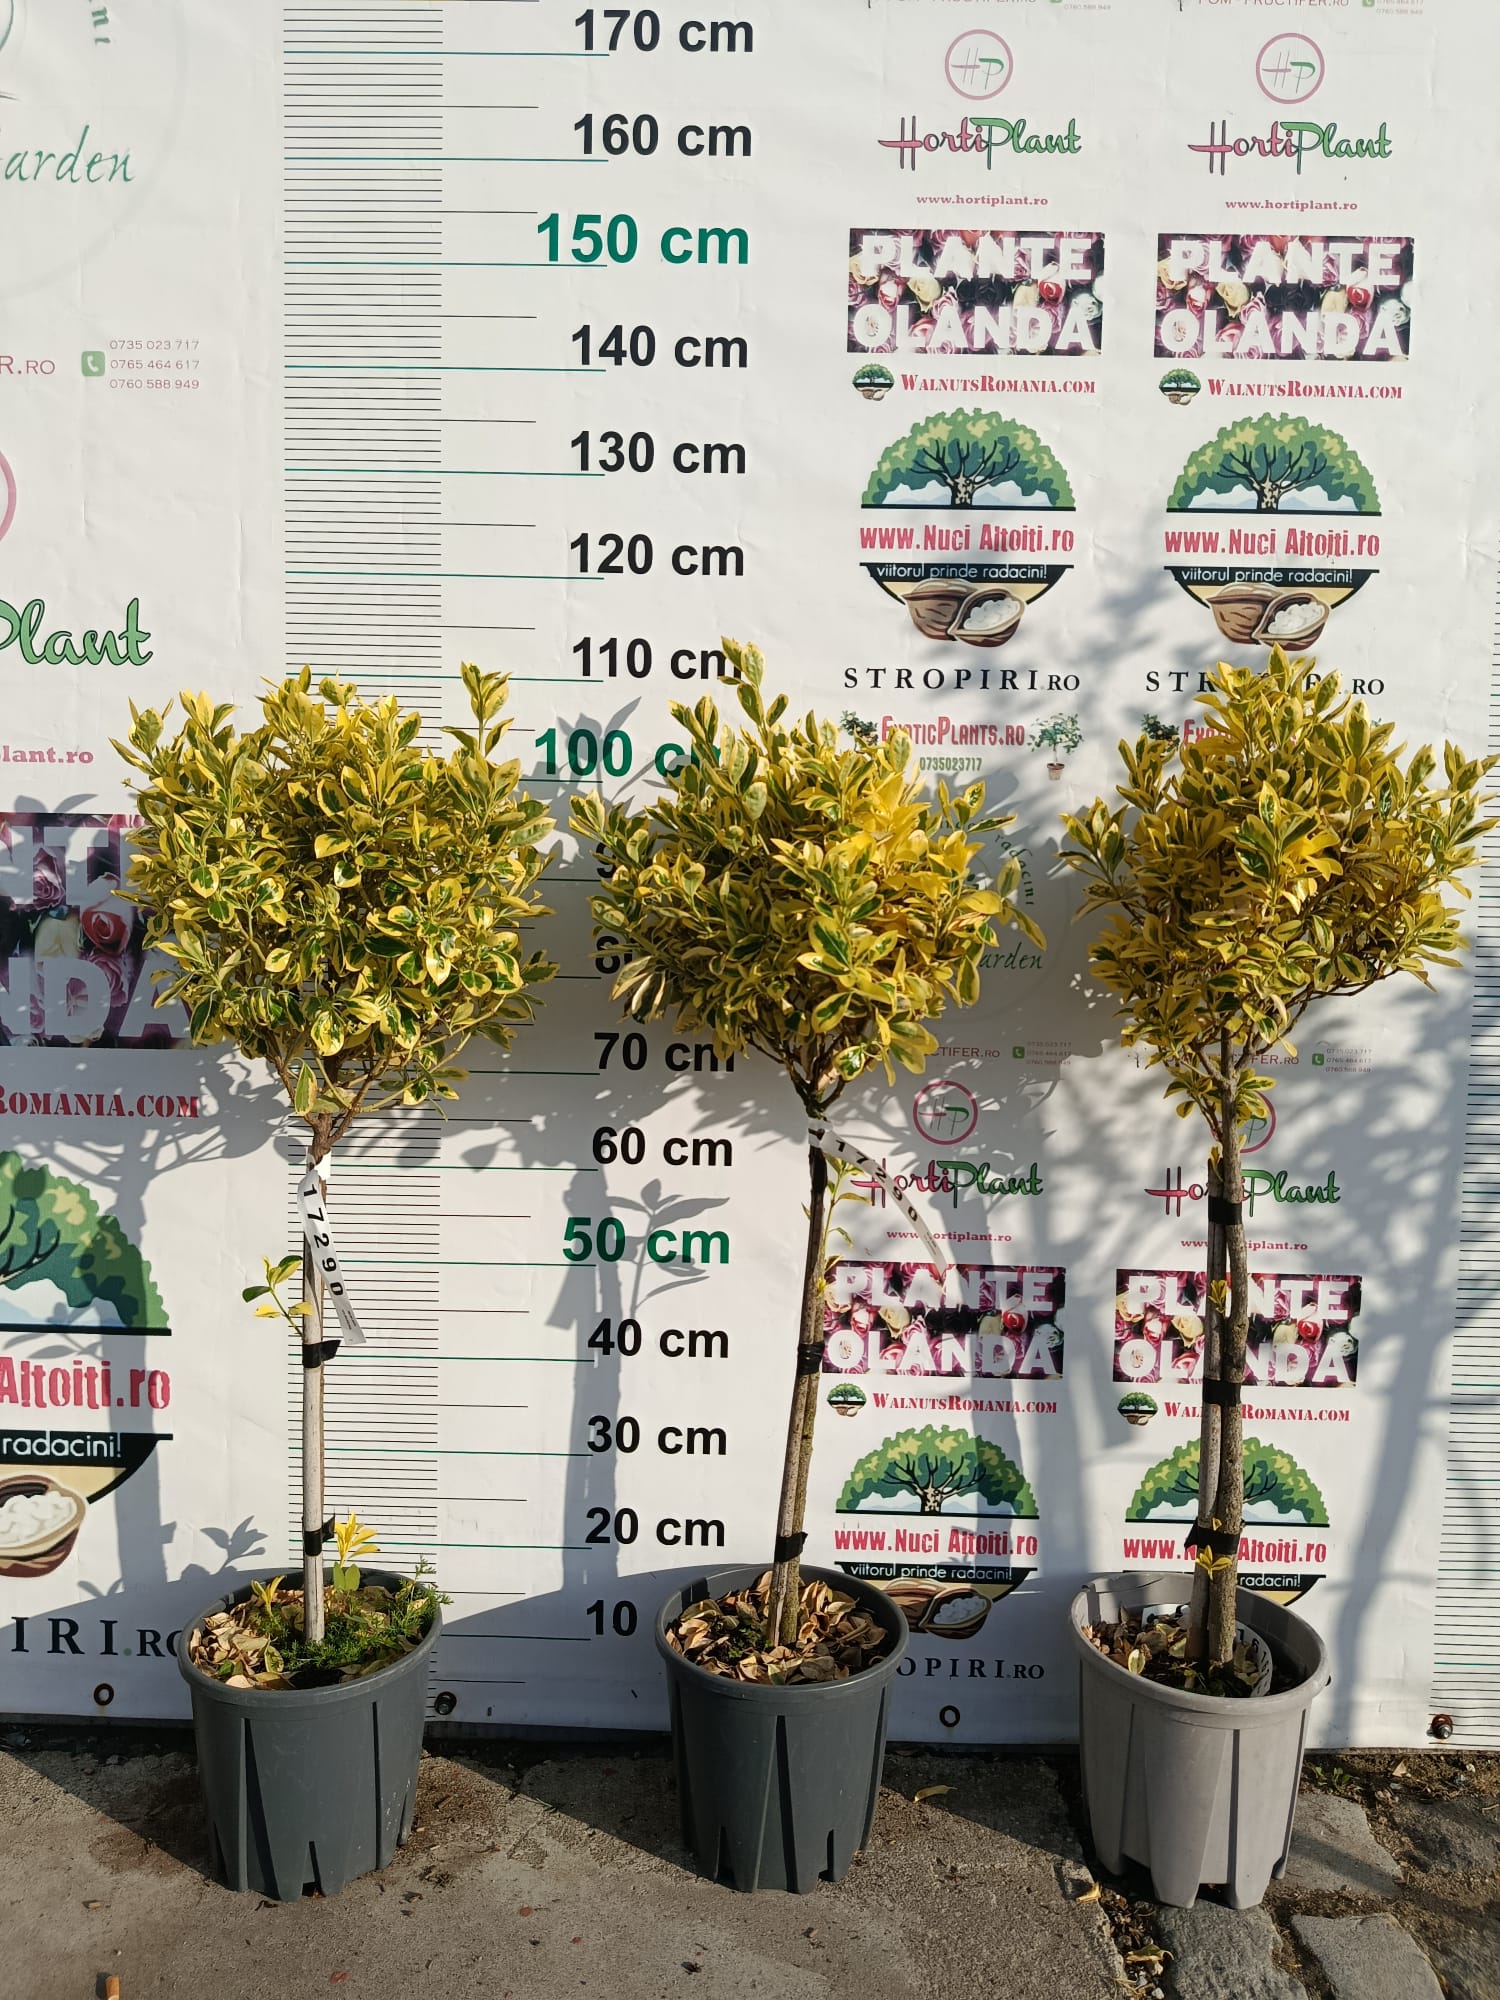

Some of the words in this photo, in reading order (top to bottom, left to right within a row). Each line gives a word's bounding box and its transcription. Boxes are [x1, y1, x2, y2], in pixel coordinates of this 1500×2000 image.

[575, 9, 660, 52] 170
[678, 19, 754, 53] cm
[0, 125, 135, 183] arden
[573, 114, 659, 156] 160
[677, 124, 752, 157] cm
[878, 115, 1082, 171] HortiPlant
[1188, 120, 1393, 176] HortiPlant
[916, 194, 1049, 207] www.hortiplant.ro
[1225, 200, 1358, 212] www.hortiplant.ro
[537, 213, 638, 264] 150
[660, 226, 749, 265] cm
[860, 234, 1093, 281] PLANTE
[1168, 239, 1401, 286] PLANTE
[109, 340, 144, 350] 0735
[146, 340, 172, 350] 023
[175, 340, 200, 350] 717
[572, 325, 656, 367] 140
[674, 336, 748, 368] cm
[853, 303, 1095, 353] OLANDA
[1160, 308, 1403, 358] OLANDA
[109, 379, 143, 390] 0760
[146, 379, 171, 390] 588
[175, 379, 200, 390] 949
[110, 359, 144, 370] 0765
[147, 359, 172, 370] 464
[176, 359, 200, 370] 617
[570, 431, 655, 473] 130
[673, 443, 746, 474] cm
[570, 533, 653, 575] 120
[671, 544, 744, 576] cm
[860, 525, 971, 550] www.Nuci
[1164, 529, 1276, 555] www.Nuci
[876, 564, 925, 578] viitorul
[930, 566, 977, 580] prinde
[983, 566, 1047, 579] radacini!
[1181, 567, 1230, 581] viitorul
[1235, 569, 1283, 583] prinde
[1289, 570, 1352, 583] radacini!
[572, 637, 651, 678] 110
[670, 650, 742, 680] cm
[844, 668, 1080, 691] STROPIRI.RO
[0, 745, 94, 764] lant.ro
[535, 728, 632, 777] 100
[919, 757, 982, 772] 0735023717
[978, 942, 1043, 970] arden
[593, 1032, 647, 1071] 70
[665, 1043, 735, 1072] cm
[0, 1086, 199, 1118] OMANIA.COM
[592, 1127, 645, 1165] 60
[663, 1137, 732, 1166] cm
[850, 1157, 1043, 1208] HortiPlant
[563, 1217, 626, 1263] 50
[647, 1230, 730, 1264] cm
[836, 1266, 1053, 1312] PLANTE
[588, 1318, 642, 1356] 40
[660, 1329, 729, 1358] cm
[828, 1329, 1056, 1374] OLANDA
[3, 1431, 121, 1457] radacini!
[587, 1415, 640, 1453] 30
[657, 1427, 727, 1455] cm
[585, 1507, 639, 1544] 20
[656, 1518, 725, 1546] cm
[835, 1529, 939, 1553] www.Nuci
[851, 1564, 896, 1577] viitorul
[901, 1565, 947, 1579] prinde
[952, 1566, 1013, 1580] radacini!
[1240, 1574, 1301, 1588] radacini!
[587, 1600, 638, 1636] 10
